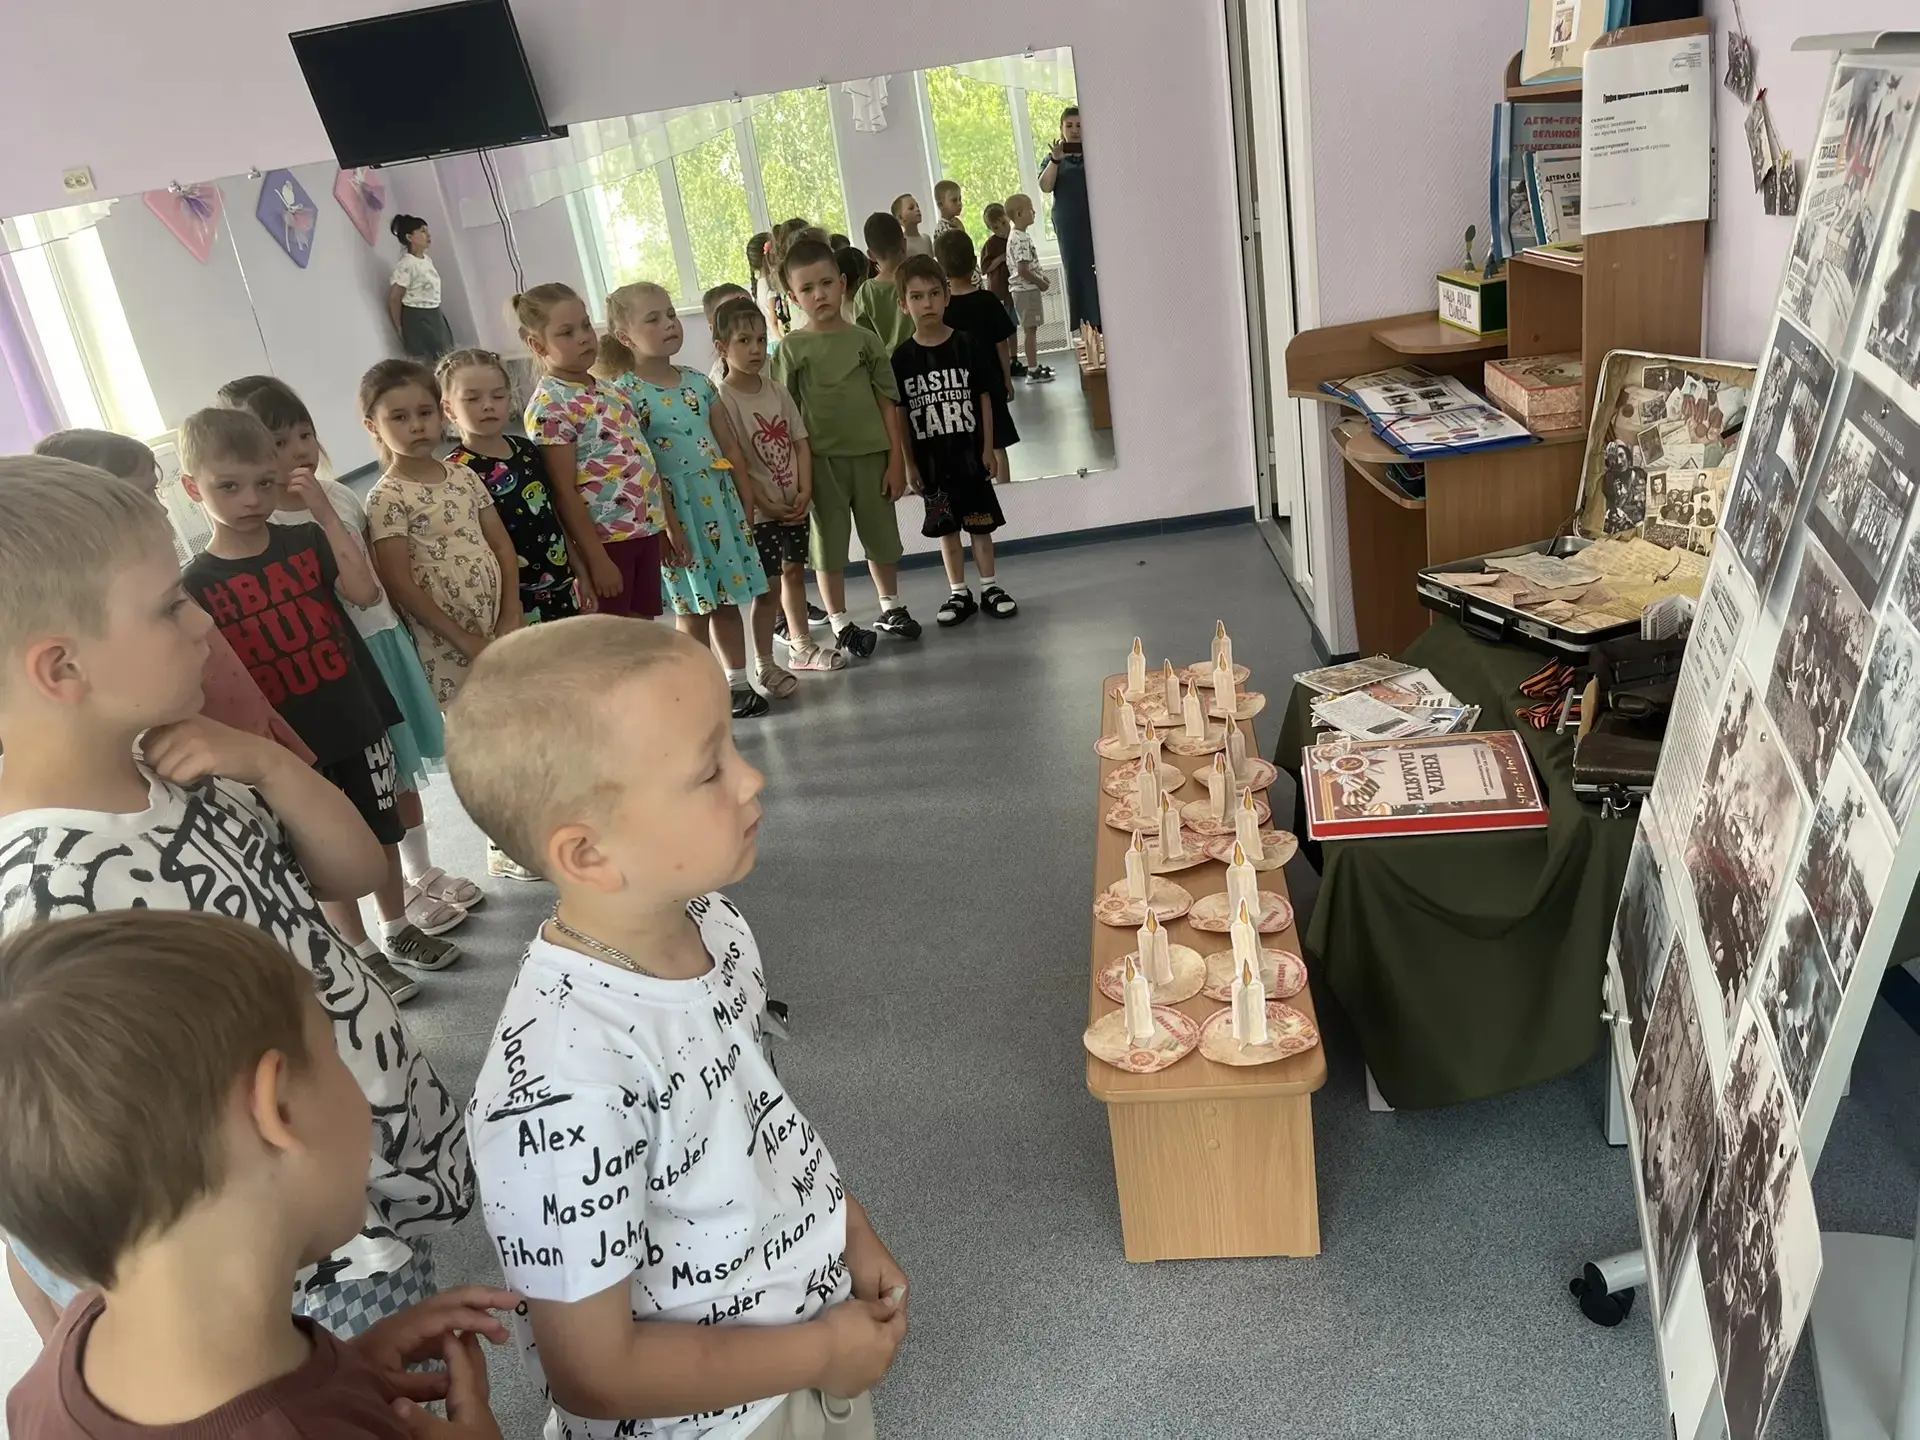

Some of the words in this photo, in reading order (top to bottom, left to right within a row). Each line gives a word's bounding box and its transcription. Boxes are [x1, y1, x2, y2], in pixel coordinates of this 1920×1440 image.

[1533, 127, 1580, 138] ВЕЛИКОЙ
[1545, 173, 1565, 182] ДЕТЯМ
[904, 368, 969, 397] EASILY
[908, 391, 961, 410] DISTRACTED
[962, 389, 971, 400] BY
[909, 400, 976, 440] CARS
[203, 547, 322, 626] #BAH
[250, 640, 347, 706] BUG
[1398, 752, 1424, 802] ПАМЯТИ
[1421, 753, 1446, 796] КНИГА
[713, 986, 748, 1034] Maso
[699, 1043, 741, 1101] Fihan
[518, 1118, 586, 1157] Alex
[762, 1113, 797, 1164] Alex
[582, 1138, 648, 1186] Jane
[791, 1148, 822, 1207] Mason
[543, 1185, 629, 1226] Mason
[496, 1235, 563, 1268] Fihan
[672, 1245, 755, 1290] Mason
[763, 1212, 816, 1271] Fihan
